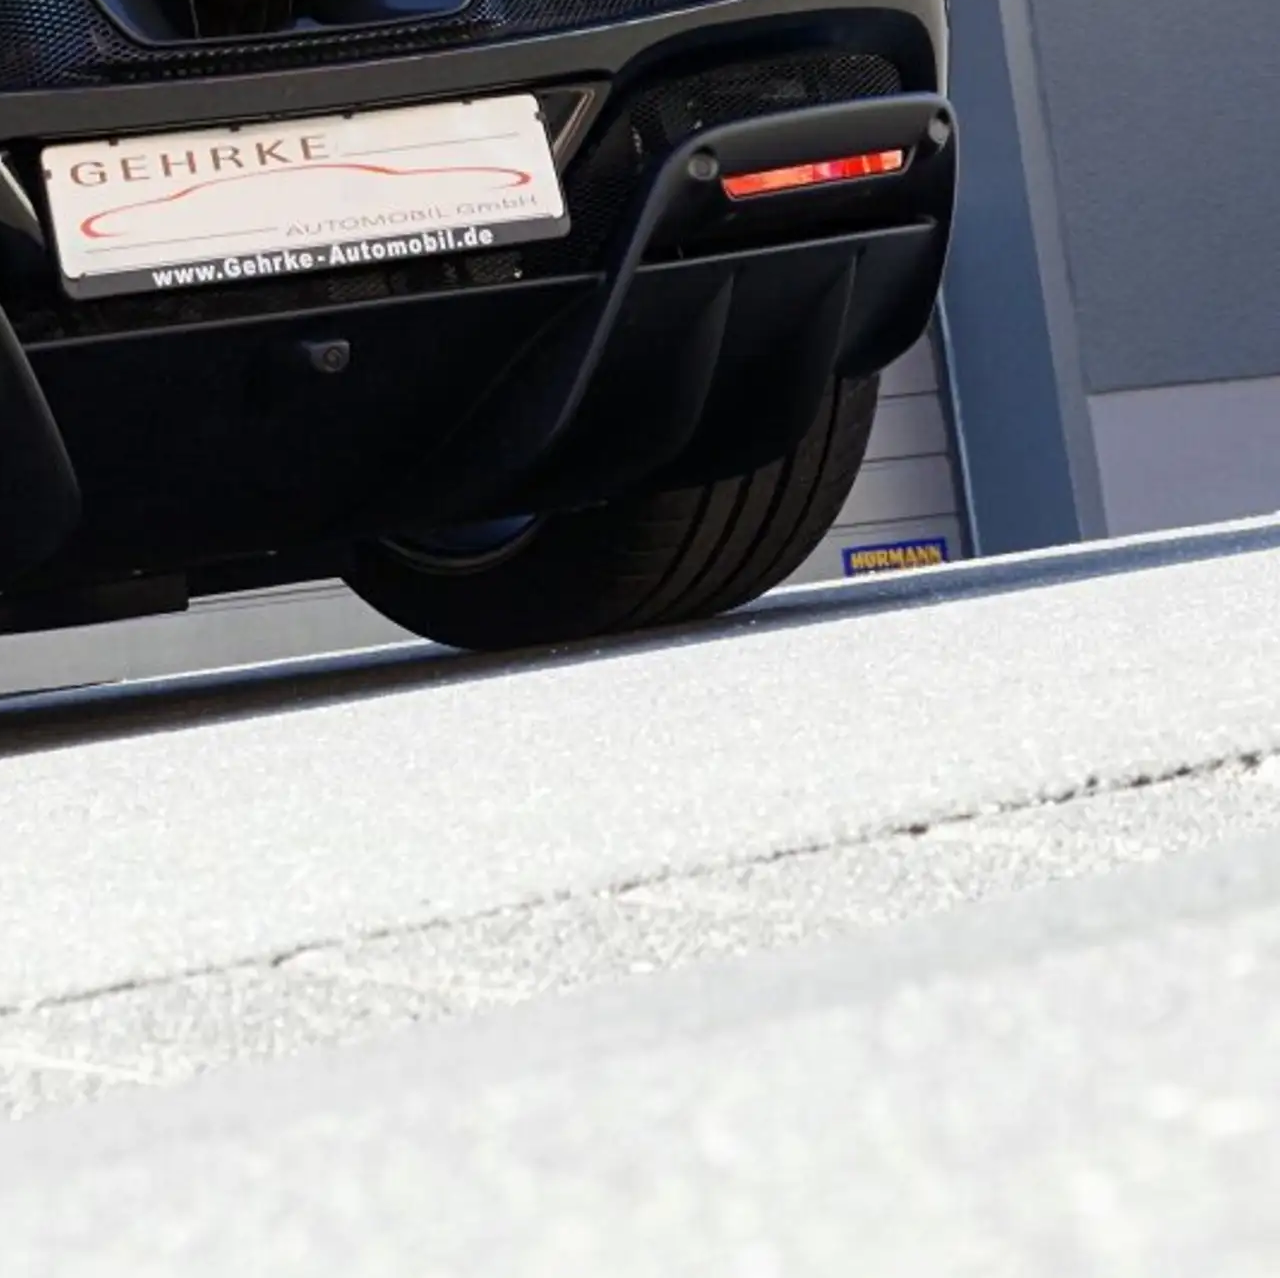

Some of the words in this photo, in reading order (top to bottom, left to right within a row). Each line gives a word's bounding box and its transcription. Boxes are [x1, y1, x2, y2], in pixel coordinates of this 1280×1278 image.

[69, 135, 329, 187] GEHRKE
[285, 205, 445, 237] AUTOMOBIL
[456, 194, 538, 216] GmbH
